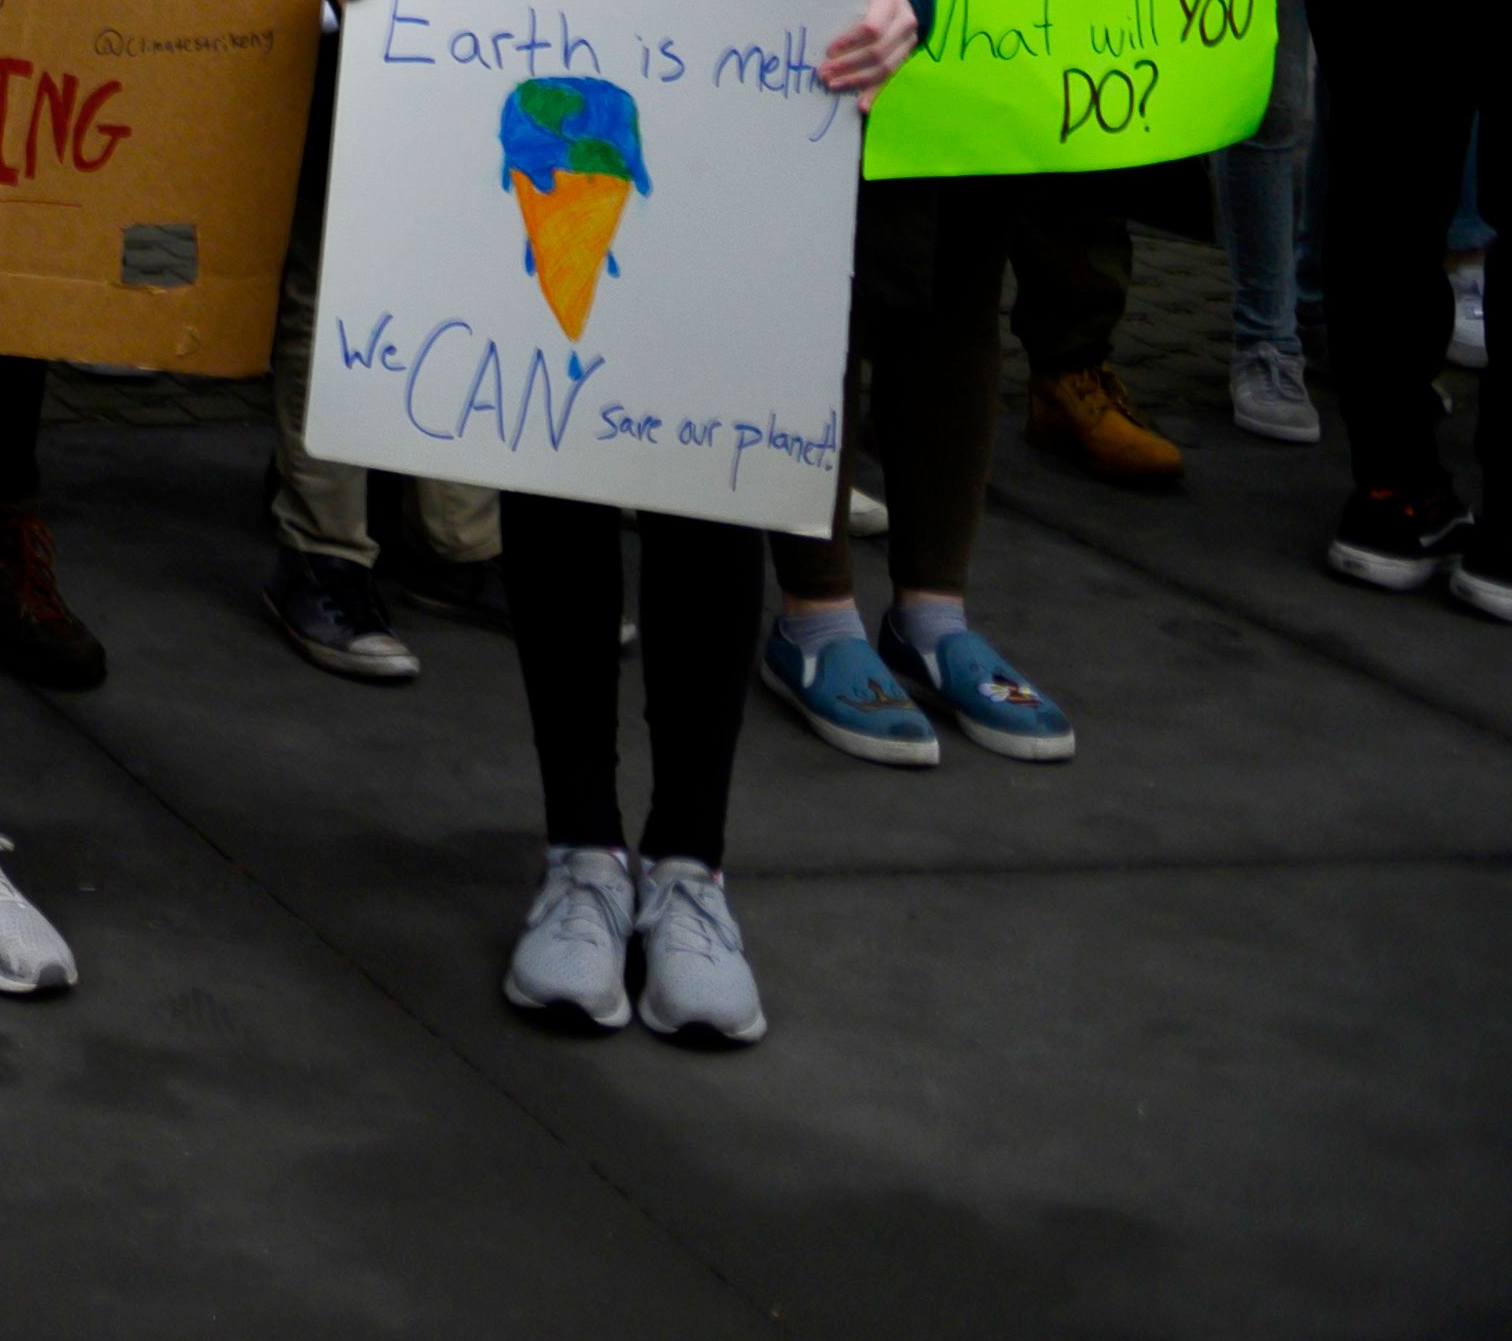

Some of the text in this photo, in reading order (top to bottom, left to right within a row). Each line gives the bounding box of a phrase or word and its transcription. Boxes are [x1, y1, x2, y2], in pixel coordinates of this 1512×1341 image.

[636, 33, 686, 84] is
[1060, 59, 1162, 145] DO?
[336, 311, 407, 373] We
[677, 421, 721, 449] our
[733, 408, 840, 493] planet!
